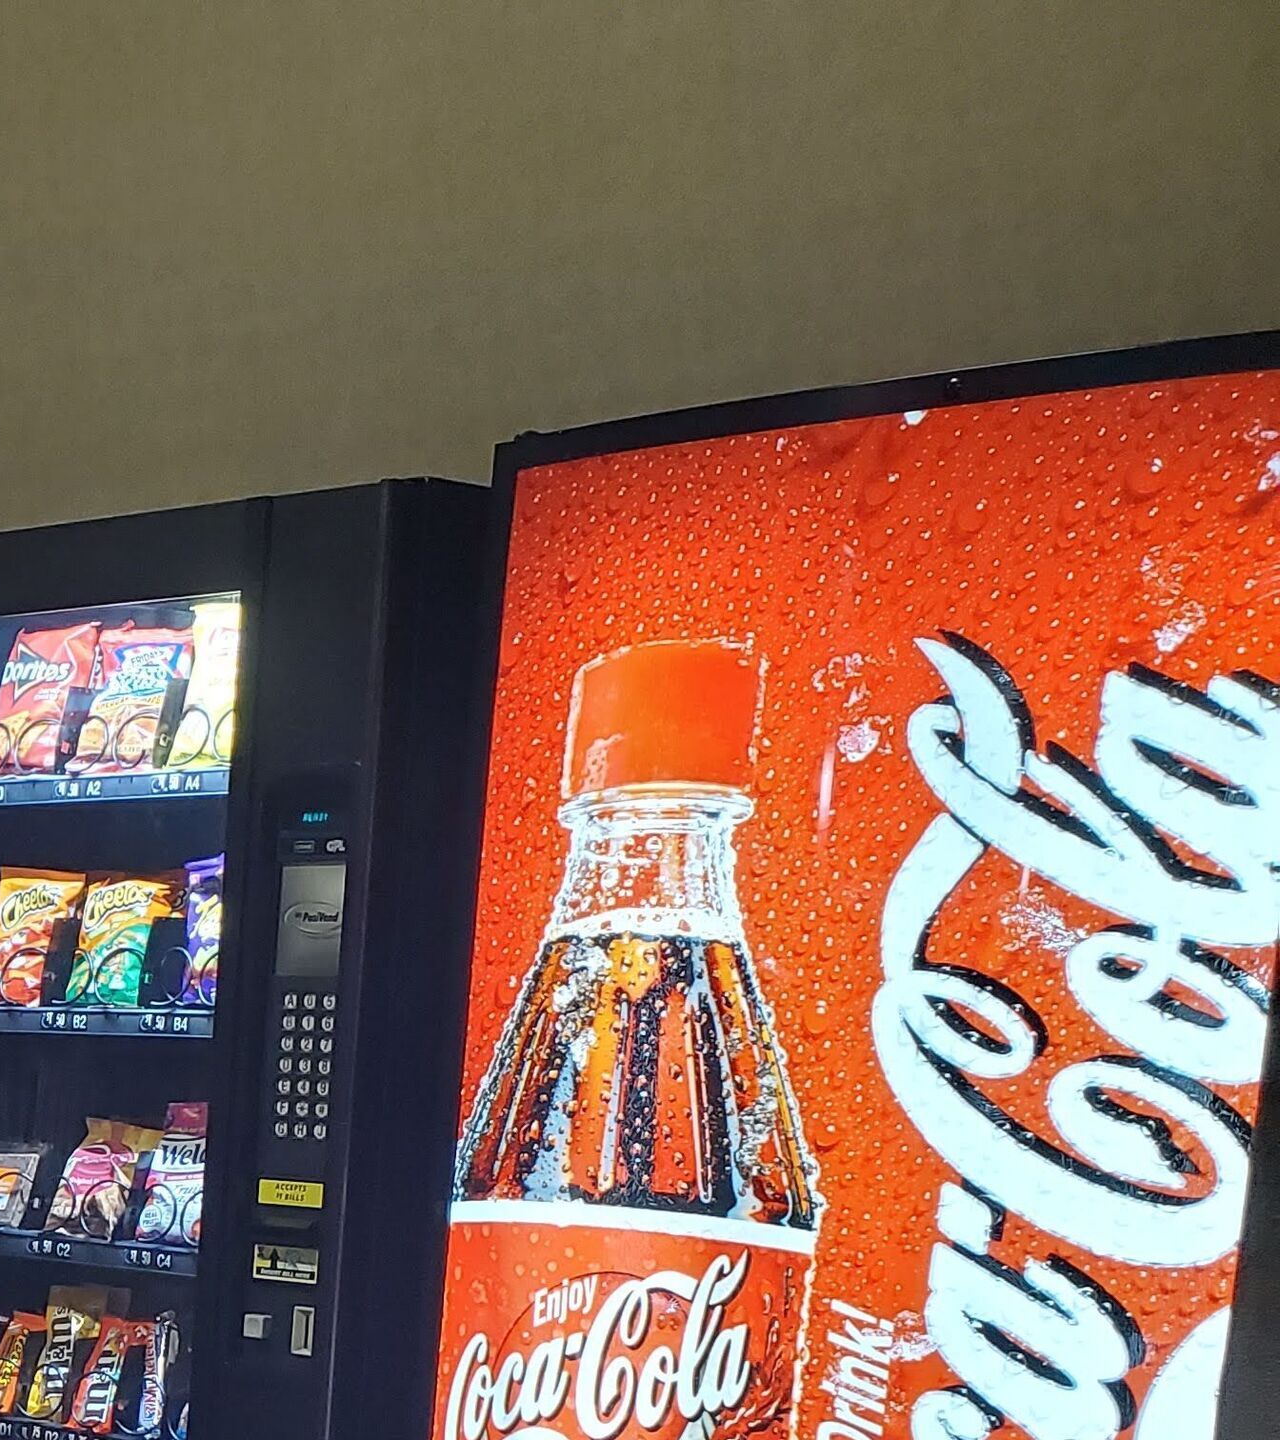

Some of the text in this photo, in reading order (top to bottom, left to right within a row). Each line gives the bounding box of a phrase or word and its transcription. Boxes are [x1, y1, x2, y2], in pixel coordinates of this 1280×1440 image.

[1, 661, 70, 686] Doritos
[87, 781, 101, 796] A2
[185, 776, 200, 791] A4
[73, 1015, 87, 1029] B2
[174, 1016, 188, 1031] B4
[275, 1183, 307, 1192] ACCEPTS
[285, 1193, 305, 1202] BILLS
[57, 1243, 71, 1257] C2
[157, 1254, 171, 1268] C4
[532, 1275, 598, 1328] Enjoy
